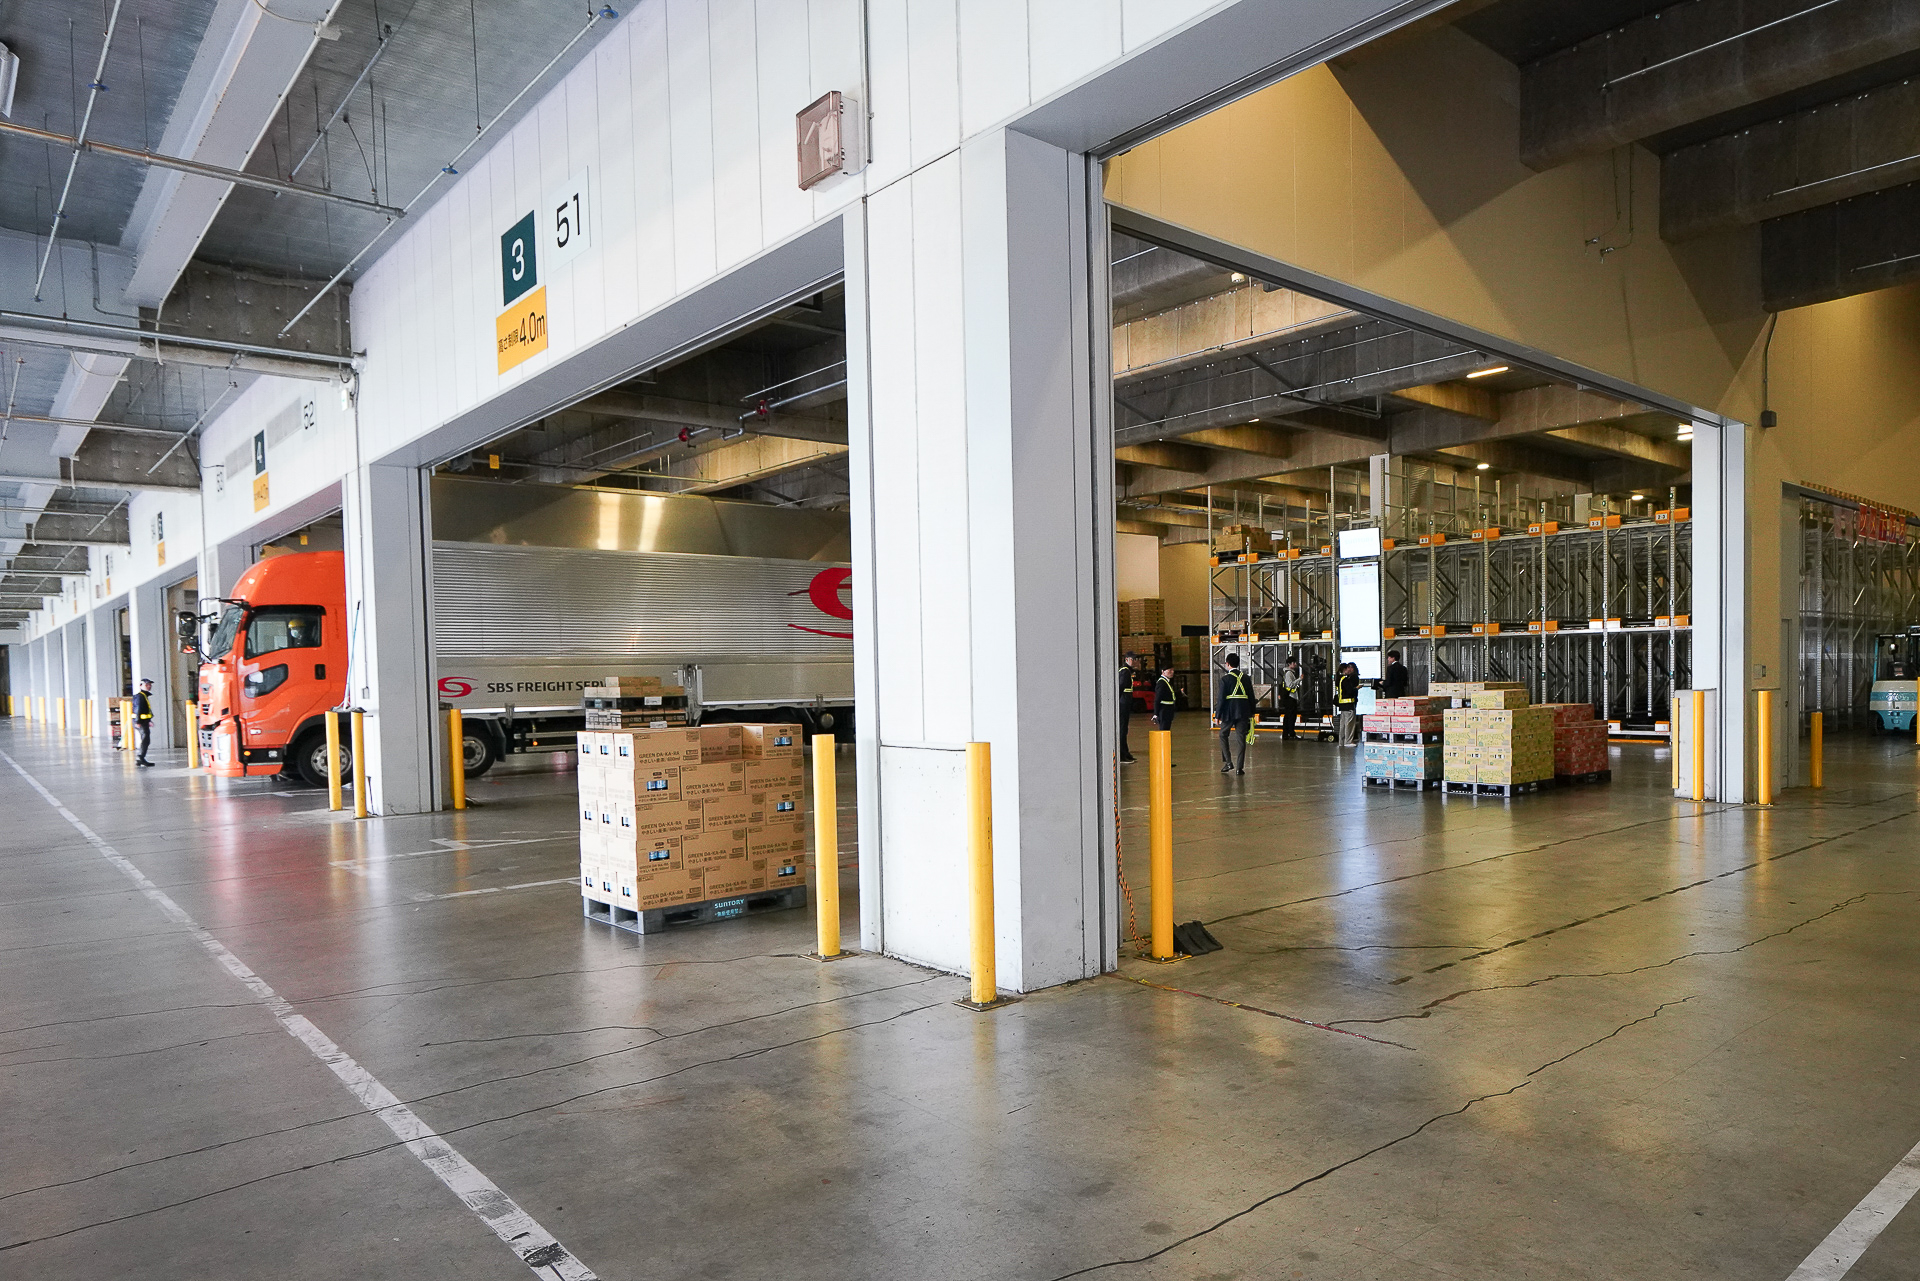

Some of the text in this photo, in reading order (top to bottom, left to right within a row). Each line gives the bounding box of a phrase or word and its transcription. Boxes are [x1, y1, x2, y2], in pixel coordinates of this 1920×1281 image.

[556, 192, 580, 248] 51
[511, 238, 525, 282] 3
[520, 312, 545, 346] 4.0m
[304, 400, 314, 430] 52
[256, 441, 262, 464] 4
[487, 682, 513, 693] SBS
[517, 681, 573, 692] FREIGHT
[714, 898, 744, 909] SUNTORY
